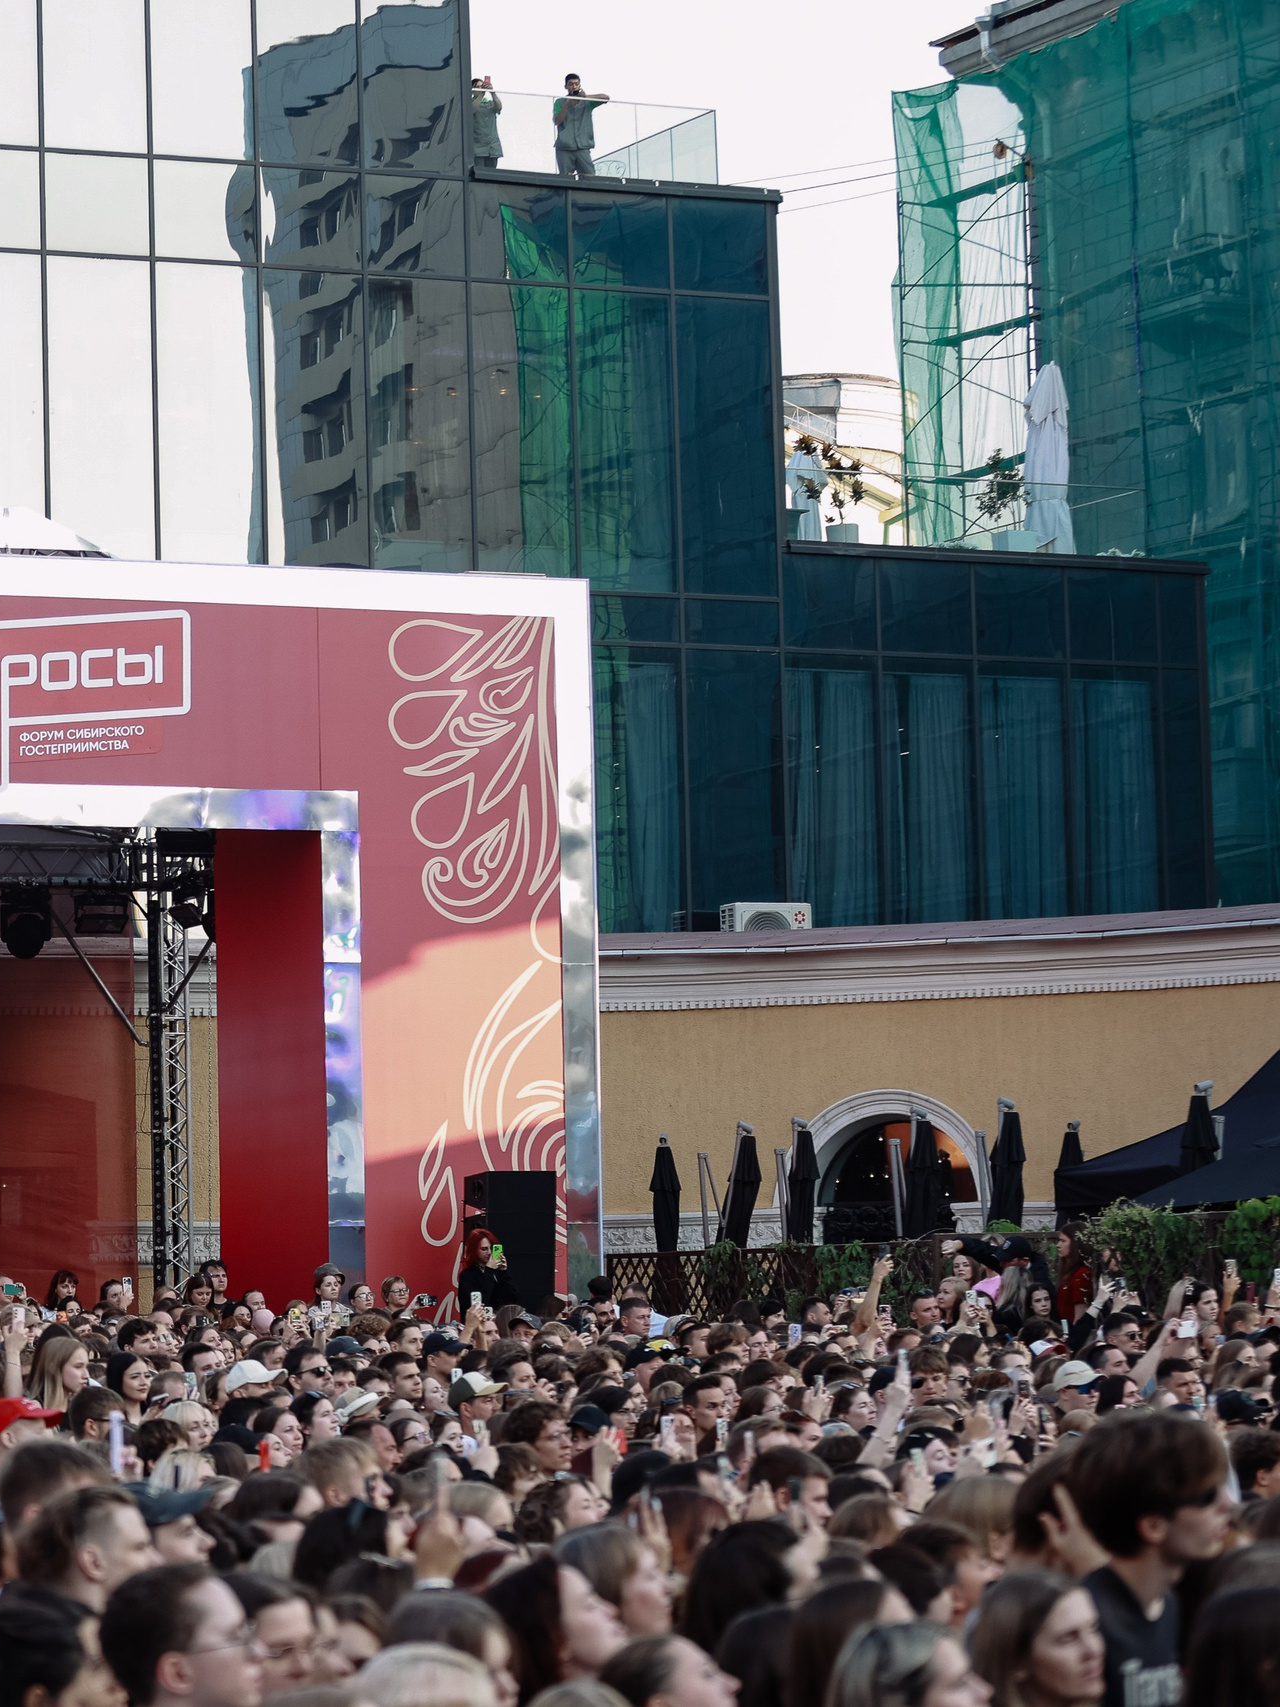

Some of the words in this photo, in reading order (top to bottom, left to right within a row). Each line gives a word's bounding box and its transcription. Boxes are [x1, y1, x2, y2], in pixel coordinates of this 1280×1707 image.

[19, 727, 64, 744] ФОРУМ
[66, 725, 145, 741] СИБИРСКОГО
[19, 739, 130, 757] ГОСТЕПРИИМСТВА
